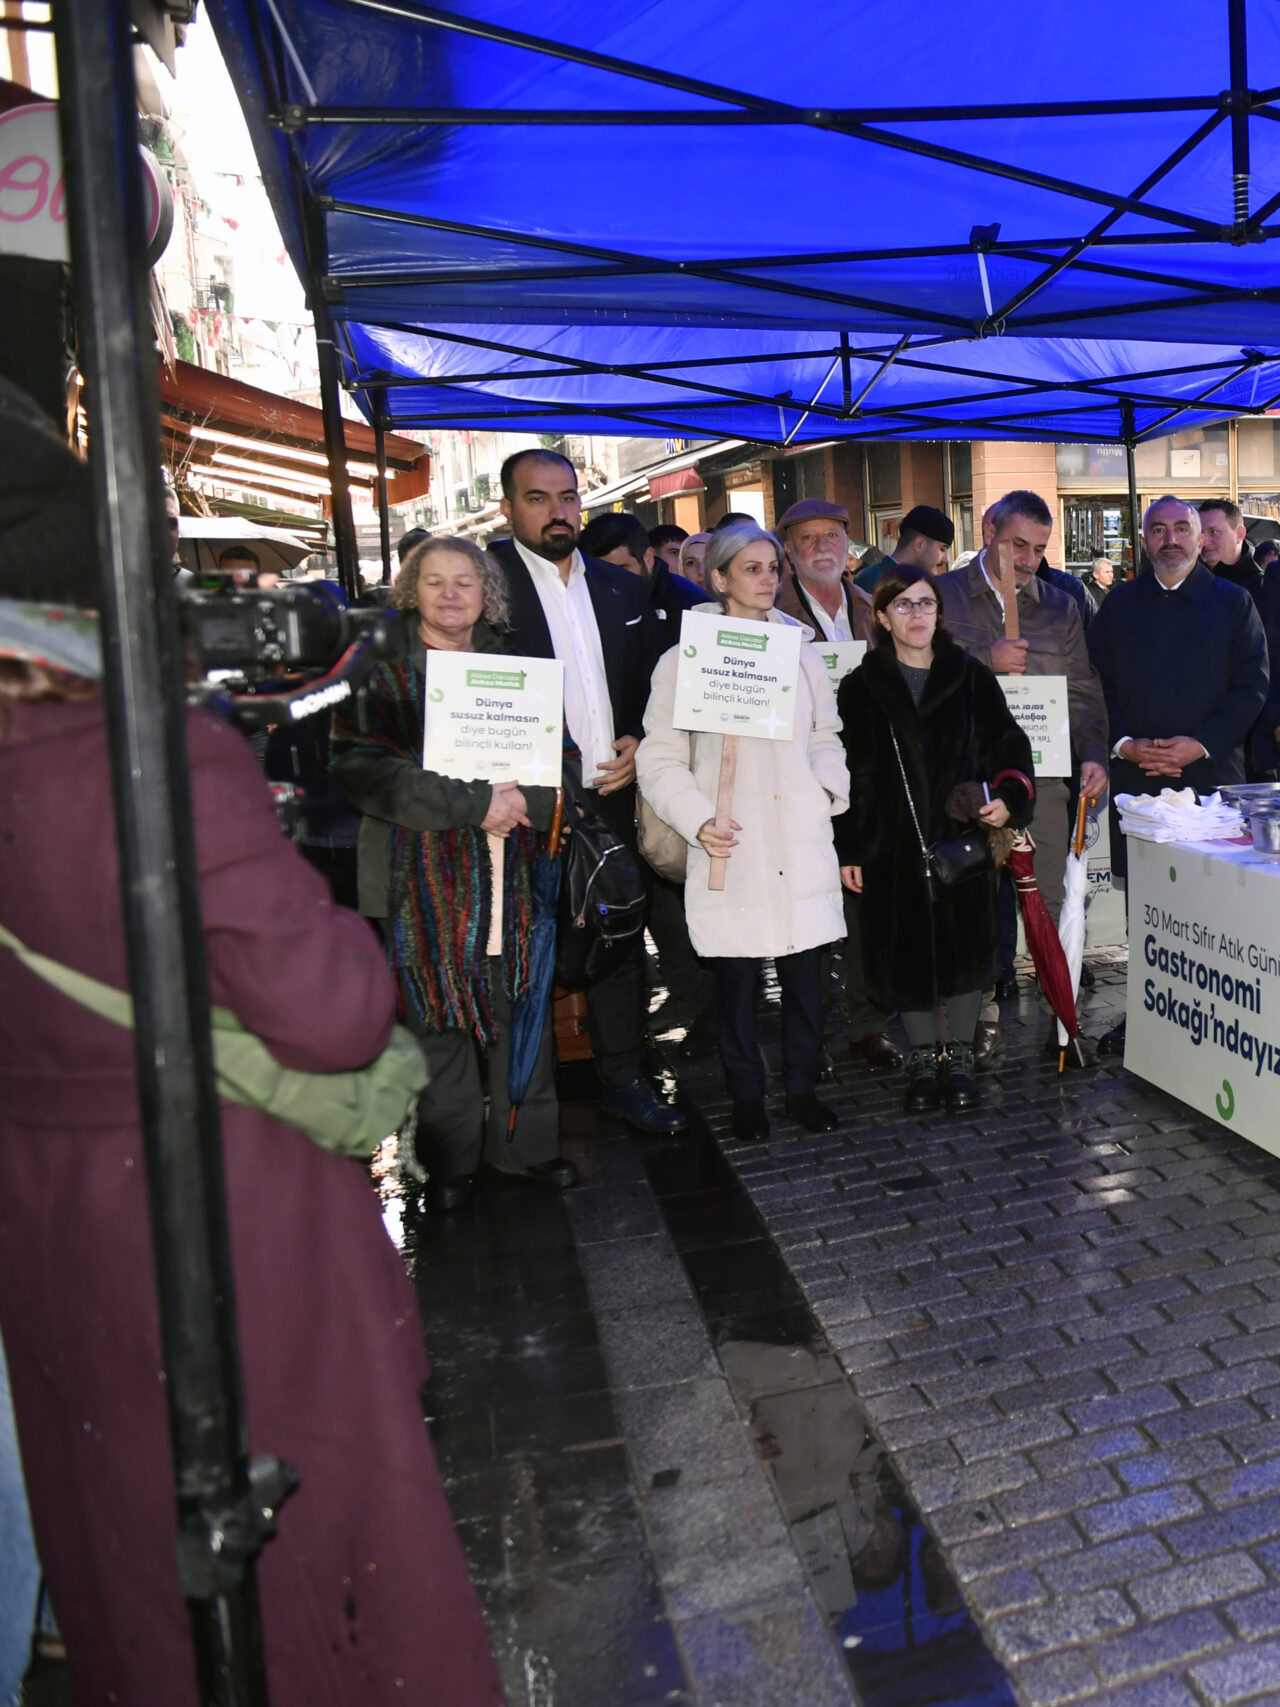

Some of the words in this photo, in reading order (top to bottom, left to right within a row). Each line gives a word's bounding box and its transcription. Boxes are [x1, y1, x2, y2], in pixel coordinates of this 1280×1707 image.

[723, 656, 756, 668] Dünya
[701, 667, 730, 677] susuz
[732, 669, 777, 682] kalmasın
[709, 680, 730, 690] diye
[732, 682, 766, 694] bugün
[475, 697, 513, 710] Dünya
[704, 691, 735, 703] bilinçli
[737, 695, 770, 707] kullan!
[450, 712, 484, 720] susuz
[486, 712, 540, 723] kalmasın
[460, 725, 485, 736] diye
[488, 726, 526, 738] bugün
[1022, 724, 1048, 732] ürünle
[455, 738, 492, 749] bilinçli
[494, 740, 533, 751] kullan!
[1144, 904, 1159, 928] 30
[1161, 911, 1190, 941] Mart
[1192, 921, 1215, 950] Sıfır
[1218, 936, 1244, 963] Atık
[1144, 934, 1261, 1014] Gastronomi
